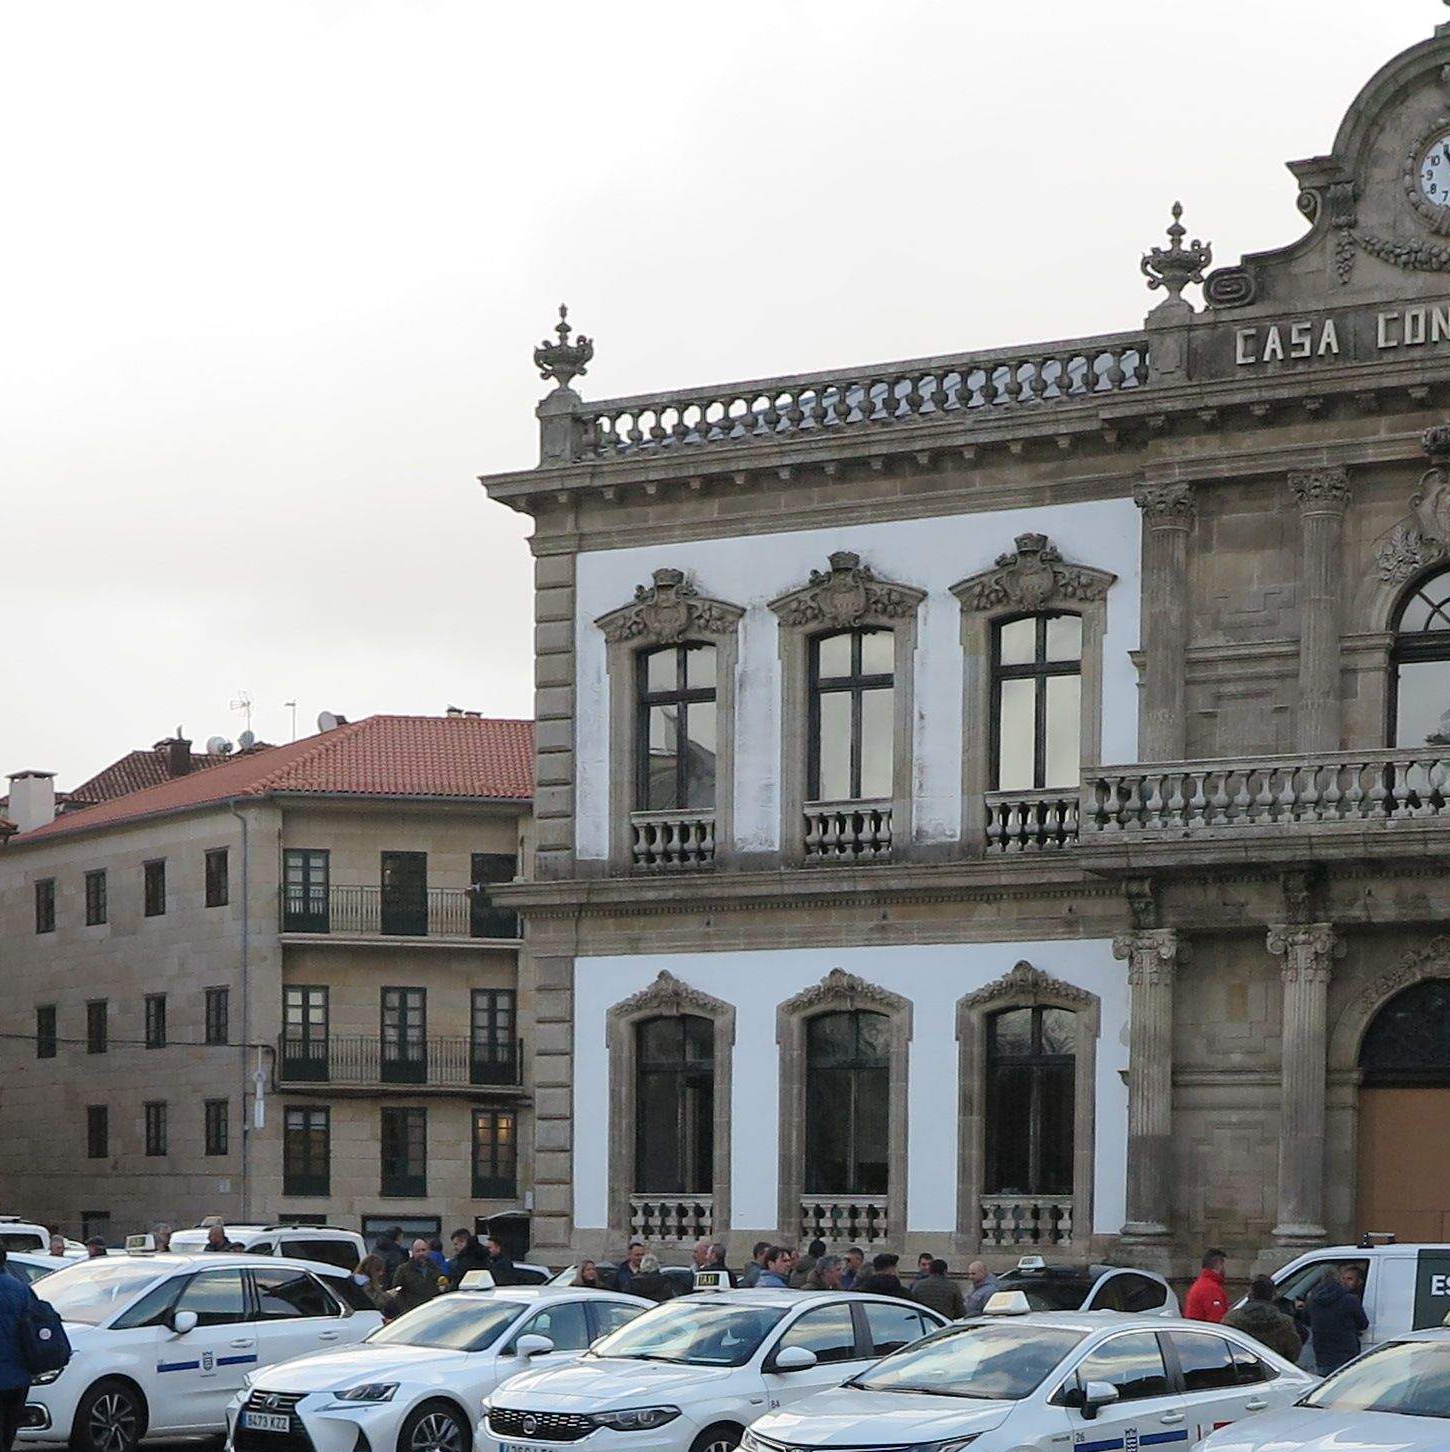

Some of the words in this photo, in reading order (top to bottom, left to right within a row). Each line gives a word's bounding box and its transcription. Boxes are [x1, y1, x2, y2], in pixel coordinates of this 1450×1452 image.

[1431, 155, 1441, 166] 10
[1426, 169, 1433, 181] 9
[1430, 183, 1437, 195] 8
[1442, 190, 1449, 202] 7
[1235, 318, 1340, 365] CASA
[1075, 1432, 1086, 1444] 26
